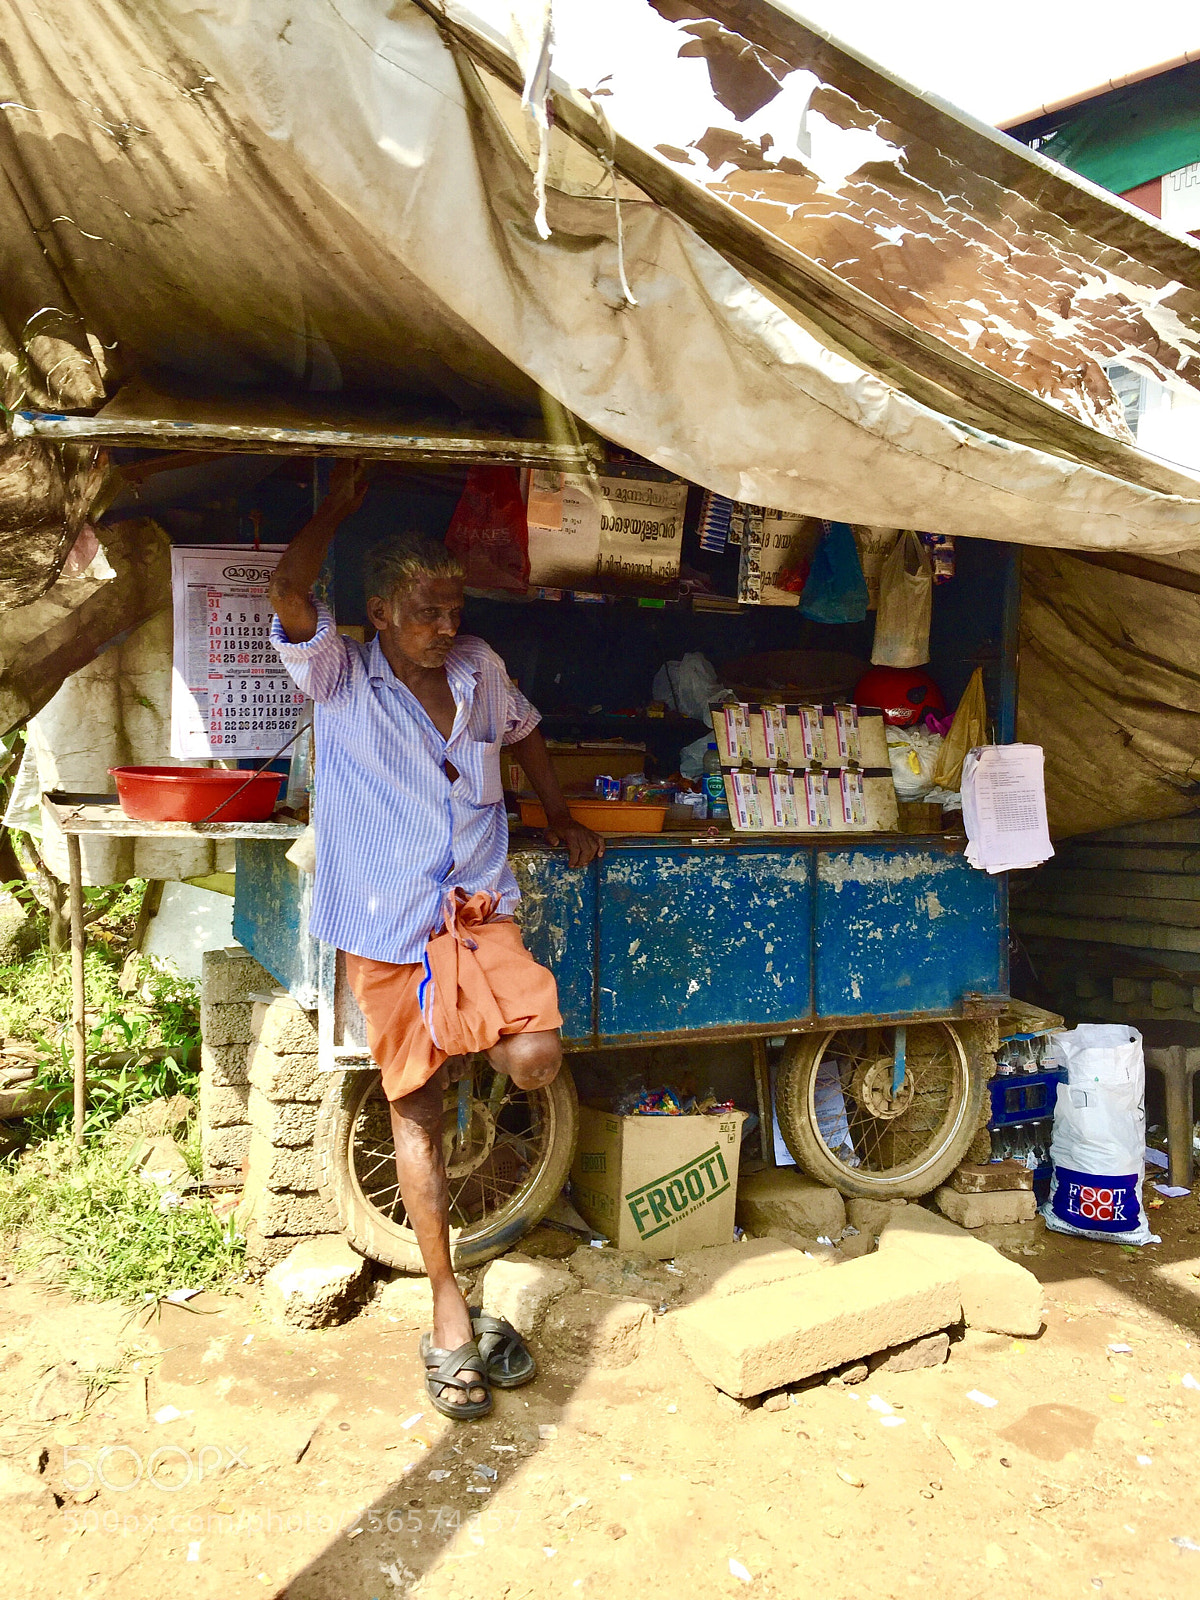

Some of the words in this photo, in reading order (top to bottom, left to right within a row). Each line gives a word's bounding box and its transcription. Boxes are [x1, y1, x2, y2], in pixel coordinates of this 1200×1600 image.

[208, 599, 220, 609] 31
[211, 613, 218, 622] 3
[226, 613, 232, 622] 4
[240, 613, 246, 622] 5
[254, 614, 260, 623] 6
[267, 614, 274, 623] 7
[209, 627, 221, 636] 10
[223, 627, 235, 636] 11
[237, 627, 249, 636] 12
[252, 627, 263, 636] 13
[210, 640, 222, 650] 17
[224, 640, 236, 650] 18
[238, 640, 250, 650] 19
[251, 640, 263, 650] 20
[209, 654, 222, 663] 24
[223, 654, 236, 663] 25
[237, 654, 250, 663] 26
[251, 654, 263, 664] 27
[265, 654, 277, 664] 28
[227, 681, 232, 689] 1
[241, 681, 247, 689] 2
[254, 681, 260, 689] 3
[268, 681, 274, 689] 4
[282, 681, 288, 689] 5
[213, 694, 219, 703] 7
[227, 694, 233, 703] 8
[241, 694, 247, 703] 9
[252, 694, 264, 703] 10
[266, 694, 276, 703] 11
[280, 694, 291, 703] 12
[293, 694, 304, 703] 13
[211, 708, 223, 717] 14
[225, 708, 236, 717] 15
[239, 708, 250, 717] 16
[252, 708, 264, 717] 17
[266, 708, 277, 717] 18
[280, 708, 291, 717] 19
[292, 708, 303, 717] 20
[210, 721, 222, 730] 21
[224, 721, 237, 730] 22
[238, 721, 250, 730] 23
[252, 721, 264, 730] 24
[266, 721, 277, 730] 25
[279, 721, 291, 730] 26
[210, 735, 223, 744] 28
[224, 735, 237, 744] 29
[628, 1152, 729, 1233] FROOTI
[1069, 1183, 1126, 1206] FOOT
[1067, 1198, 1127, 1221] LOCK
